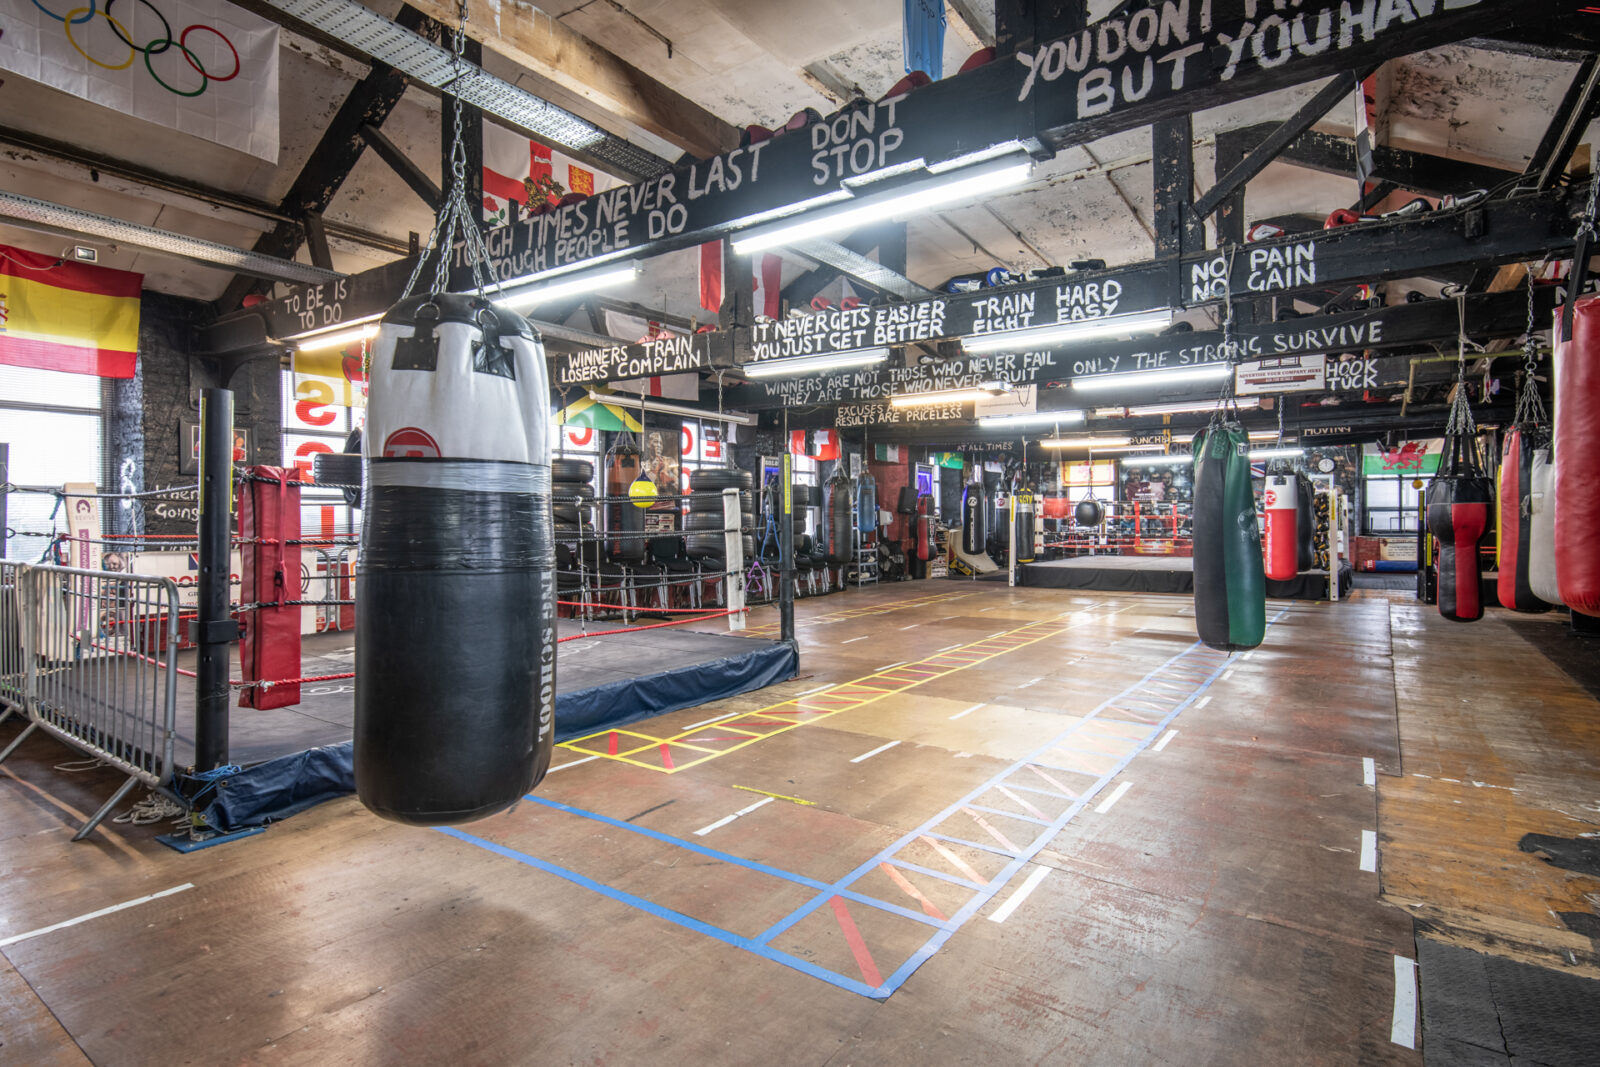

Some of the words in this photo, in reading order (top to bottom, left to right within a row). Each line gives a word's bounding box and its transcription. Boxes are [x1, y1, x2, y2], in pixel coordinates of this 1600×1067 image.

[1016, 30, 1091, 101] YOU
[1077, 42, 1204, 119] BUT
[1216, 8, 1332, 81] YOU
[1338, 0, 1481, 50] HA
[812, 93, 909, 150] DONT
[812, 127, 904, 186] STOP
[453, 228, 514, 268] TOUGH
[524, 200, 588, 249] TIMES
[596, 172, 677, 227] NEVER
[688, 140, 770, 200] LAST
[491, 243, 547, 281] TOUGH
[554, 220, 630, 266] PEOPLE
[648, 203, 688, 239] DO
[1191, 256, 1227, 284] NO
[1250, 240, 1315, 272] PAIN
[284, 295, 300, 314] TO
[306, 285, 324, 310] BE
[335, 279, 347, 300] IS
[971, 291, 1036, 318] TRAIN
[1056, 279, 1122, 308] HARD
[1192, 278, 1228, 301] NO
[1247, 261, 1316, 291] GAIN
[298, 310, 315, 329] TO
[324, 302, 342, 324] DO
[753, 324, 769, 342] IT
[774, 313, 830, 340] NEVER
[830, 308, 870, 333] GETS
[875, 300, 946, 326] EASIER
[973, 311, 1035, 334] FIGHT
[1056, 300, 1119, 323] EASY
[568, 345, 628, 369] WINNERS
[641, 335, 693, 358] TRAIN
[753, 341, 780, 361] YOU
[781, 333, 826, 356] JUST
[829, 330, 866, 350] GET
[874, 319, 944, 345] BETTER
[1073, 355, 1120, 375] ONLY
[1132, 351, 1171, 369] THE
[1179, 336, 1262, 364] STRONG
[1273, 320, 1383, 353] SURVIVE
[561, 364, 609, 383] LOSERS
[617, 349, 700, 377] COMPLAIN
[765, 378, 822, 396] WINNERS
[827, 374, 851, 389] ARE
[854, 370, 880, 387] NOT
[889, 364, 928, 382] THOSE
[932, 361, 963, 378] WHO
[968, 354, 1016, 373] NEVER
[1023, 351, 1057, 368] FAIL
[780, 391, 811, 405] THEY
[817, 388, 842, 402] ARE
[850, 382, 899, 399] THOSE
[904, 379, 933, 393] WHO
[934, 373, 983, 390] NEVER
[998, 367, 1040, 383] QUIT
[1326, 358, 1378, 378] HOOK
[1326, 374, 1377, 391] TUCK
[835, 414, 875, 428] RESULTS
[878, 411, 900, 424] ARE
[906, 407, 962, 422] PRICELESS
[837, 404, 884, 418] EXCUSES
[155, 503, 199, 522] Going
[541, 571, 553, 620] ING
[538, 627, 553, 743] SCHOOL
